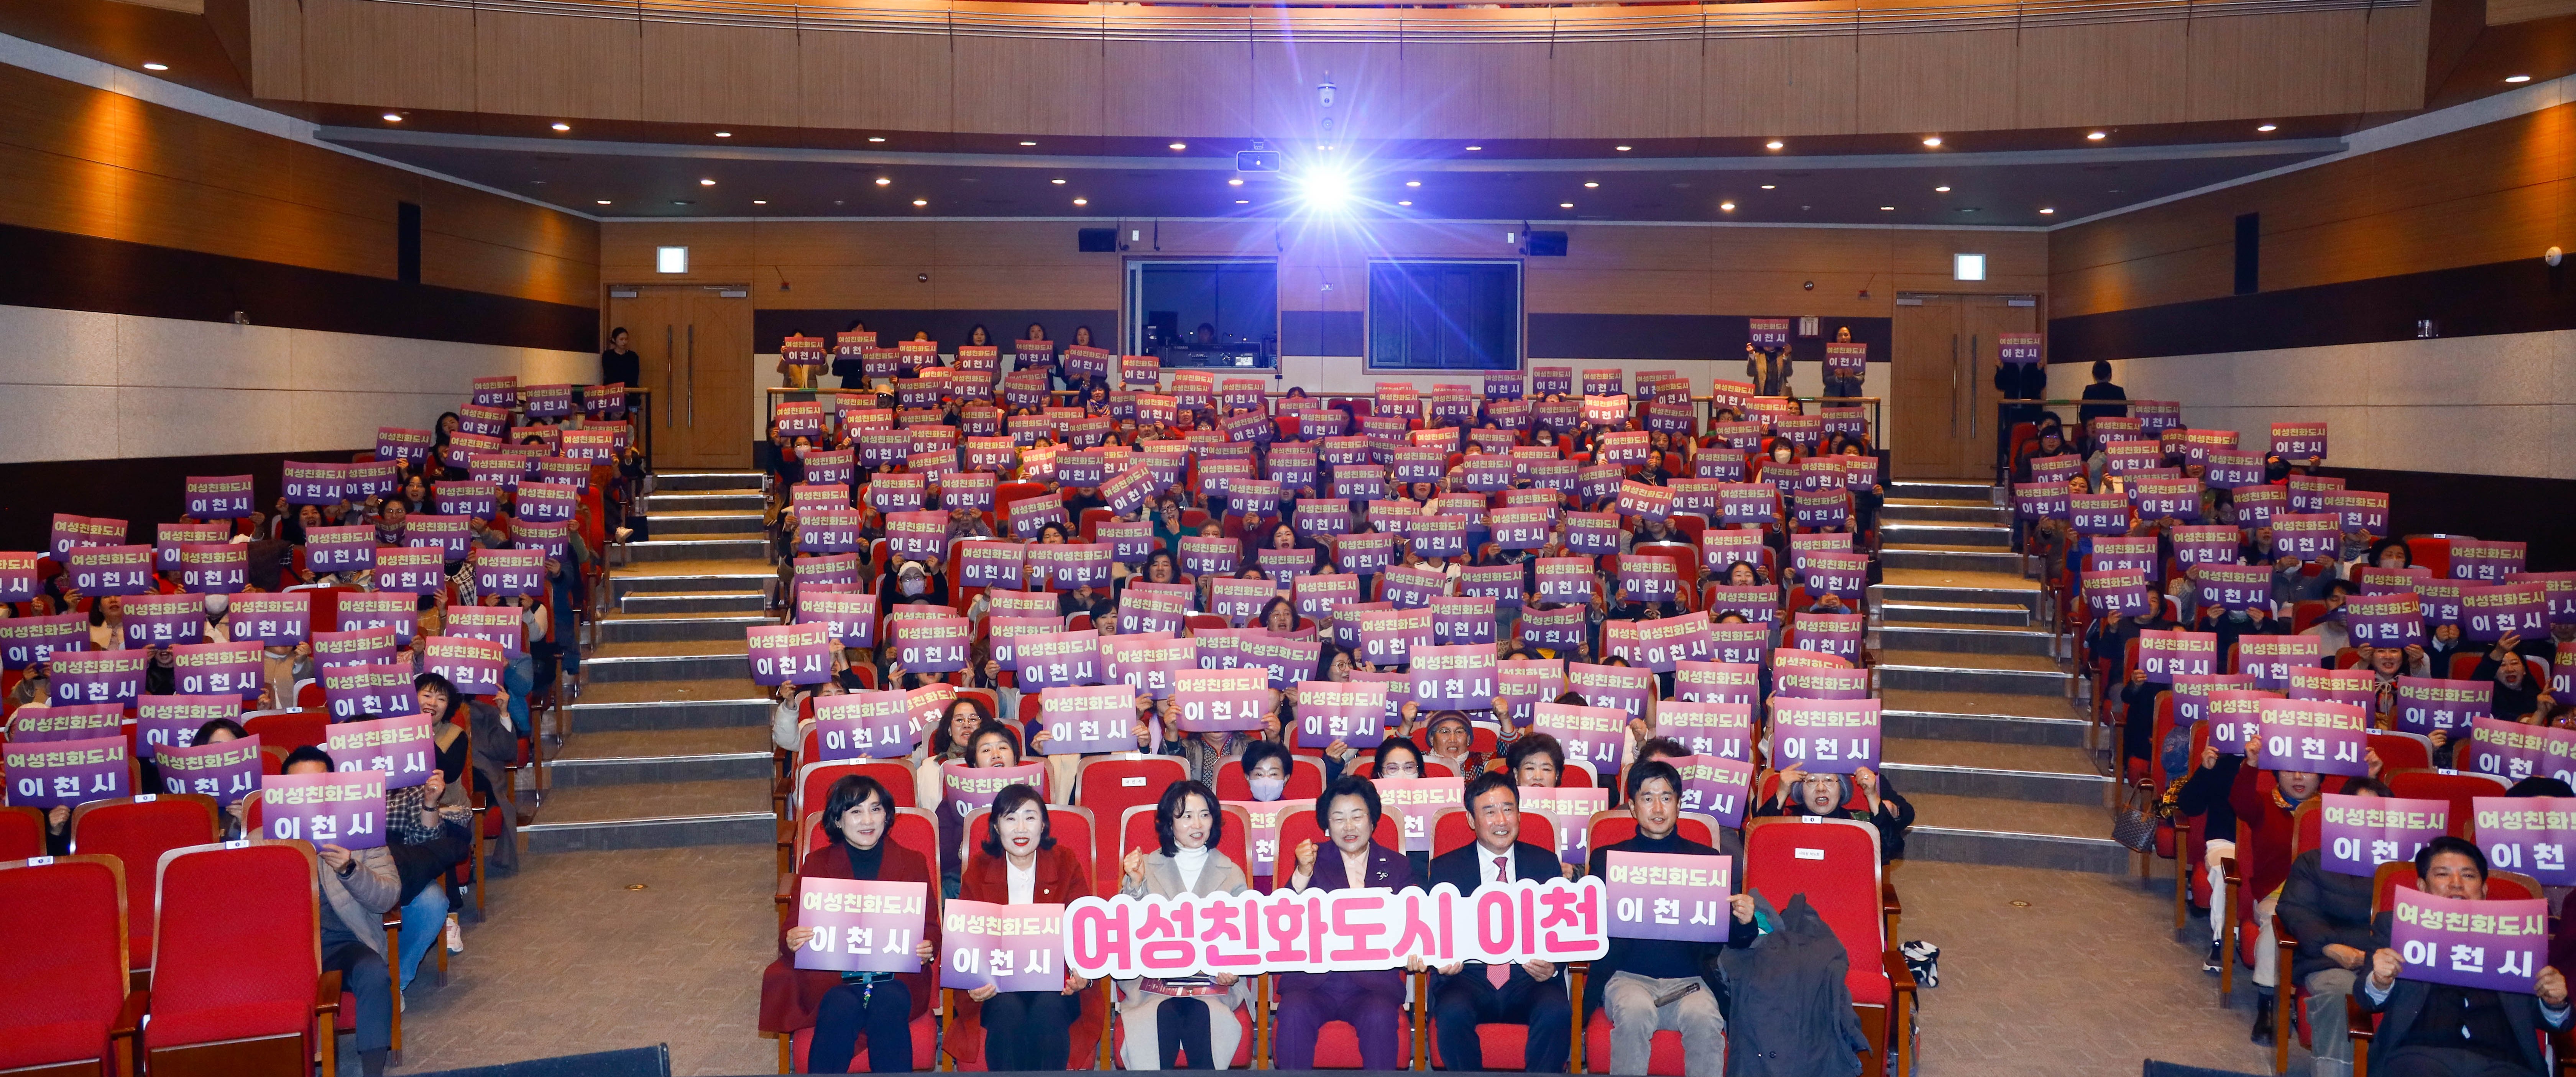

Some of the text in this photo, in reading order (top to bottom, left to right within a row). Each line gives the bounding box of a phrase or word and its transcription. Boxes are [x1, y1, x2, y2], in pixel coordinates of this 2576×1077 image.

[526, 389, 570, 397] 여성친화도시
[379, 432, 429, 443] 여성친화도시
[2272, 428, 2325, 436] 여성친화도시
[861, 435, 910, 443] 여성친화도시
[1605, 436, 1648, 445] 여성친화도시
[2108, 446, 2158, 454] 여성친화도시
[1056, 456, 1103, 465] 여성친화도시
[1697, 453, 1743, 461] 여성친화도시
[2208, 455, 2263, 466] 여성친화도시
[1464, 460, 1511, 468] 여성친화도시
[284, 468, 346, 479] 여성친화도시
[1335, 470, 1382, 479] 여성친화도시
[187, 482, 251, 493] 여성친화도시
[942, 479, 993, 488] 여성친화도시
[2138, 485, 2196, 494] 여성친화도시
[437, 487, 494, 496] 여성친화도시
[518, 488, 574, 500] 여성친화도시
[1721, 489, 1774, 498] 여성친화도시
[1298, 505, 1347, 513] 여성친화도시
[802, 516, 857, 525] 여성친화도시
[1492, 512, 1547, 524] 여성친화도시
[55, 521, 125, 537] 여성친화도시
[887, 521, 945, 533] 여성친화도시
[1412, 522, 1465, 531] 여성친화도시
[2273, 520, 2338, 531] 여성친화도시
[308, 532, 374, 543] 여성친화도시
[2174, 532, 2236, 542] 여성친화도시
[1183, 542, 1236, 554] 여성친화도시
[1339, 539, 1392, 550] 여성친화도시
[72, 552, 150, 565] 여성친화도시
[962, 548, 1022, 560] 여성친화도시
[2451, 547, 2523, 559] 여성친화도시
[376, 554, 442, 566] 여성친화도시
[477, 557, 543, 567] 여성친화도시
[1807, 558, 1866, 571] 여성친화도시
[2198, 570, 2269, 583] 여성친화도시
[2461, 591, 2545, 607] 여성친화도시
[122, 601, 203, 616] 여성친화도시
[229, 601, 307, 613] 여성친화도시
[898, 626, 968, 639] 여성친화도시
[1640, 619, 1708, 641] 여성친화도시
[749, 632, 826, 648] 여성친화도시
[2142, 638, 2214, 652] 여성친화도시
[1017, 639, 1097, 657] 여성친화도시
[176, 650, 262, 667] 여성친화도시
[1413, 654, 1495, 670] 여성친화도시
[53, 658, 145, 674] 여성친화도시
[1178, 678, 1265, 692] 여성친화도시
[2292, 675, 2372, 692] 여성친화도시
[1298, 691, 1383, 706] 여성친화도시
[2400, 686, 2490, 703] 여성친화도시
[1045, 694, 1132, 712] 여성친화도시
[816, 700, 905, 721] 여성친화도시
[1776, 709, 1877, 727] 여성친화도시
[2262, 708, 2365, 731] 여성친화도시
[330, 724, 431, 750] 여성친화도시
[7, 747, 124, 769] 여성친화도시
[266, 782, 382, 804] 여성친화도시
[2325, 806, 2445, 831] 여성친화도시
[2478, 811, 2576, 830] 여성친화
[1609, 865, 1727, 887] 여성친화도시
[803, 891, 922, 915] 여성친화도시
[2397, 902, 2543, 936] 여성친화도시
[947, 915, 1060, 936] 여성친화도시
[1073, 885, 1599, 969] 여성친화도시 이천
